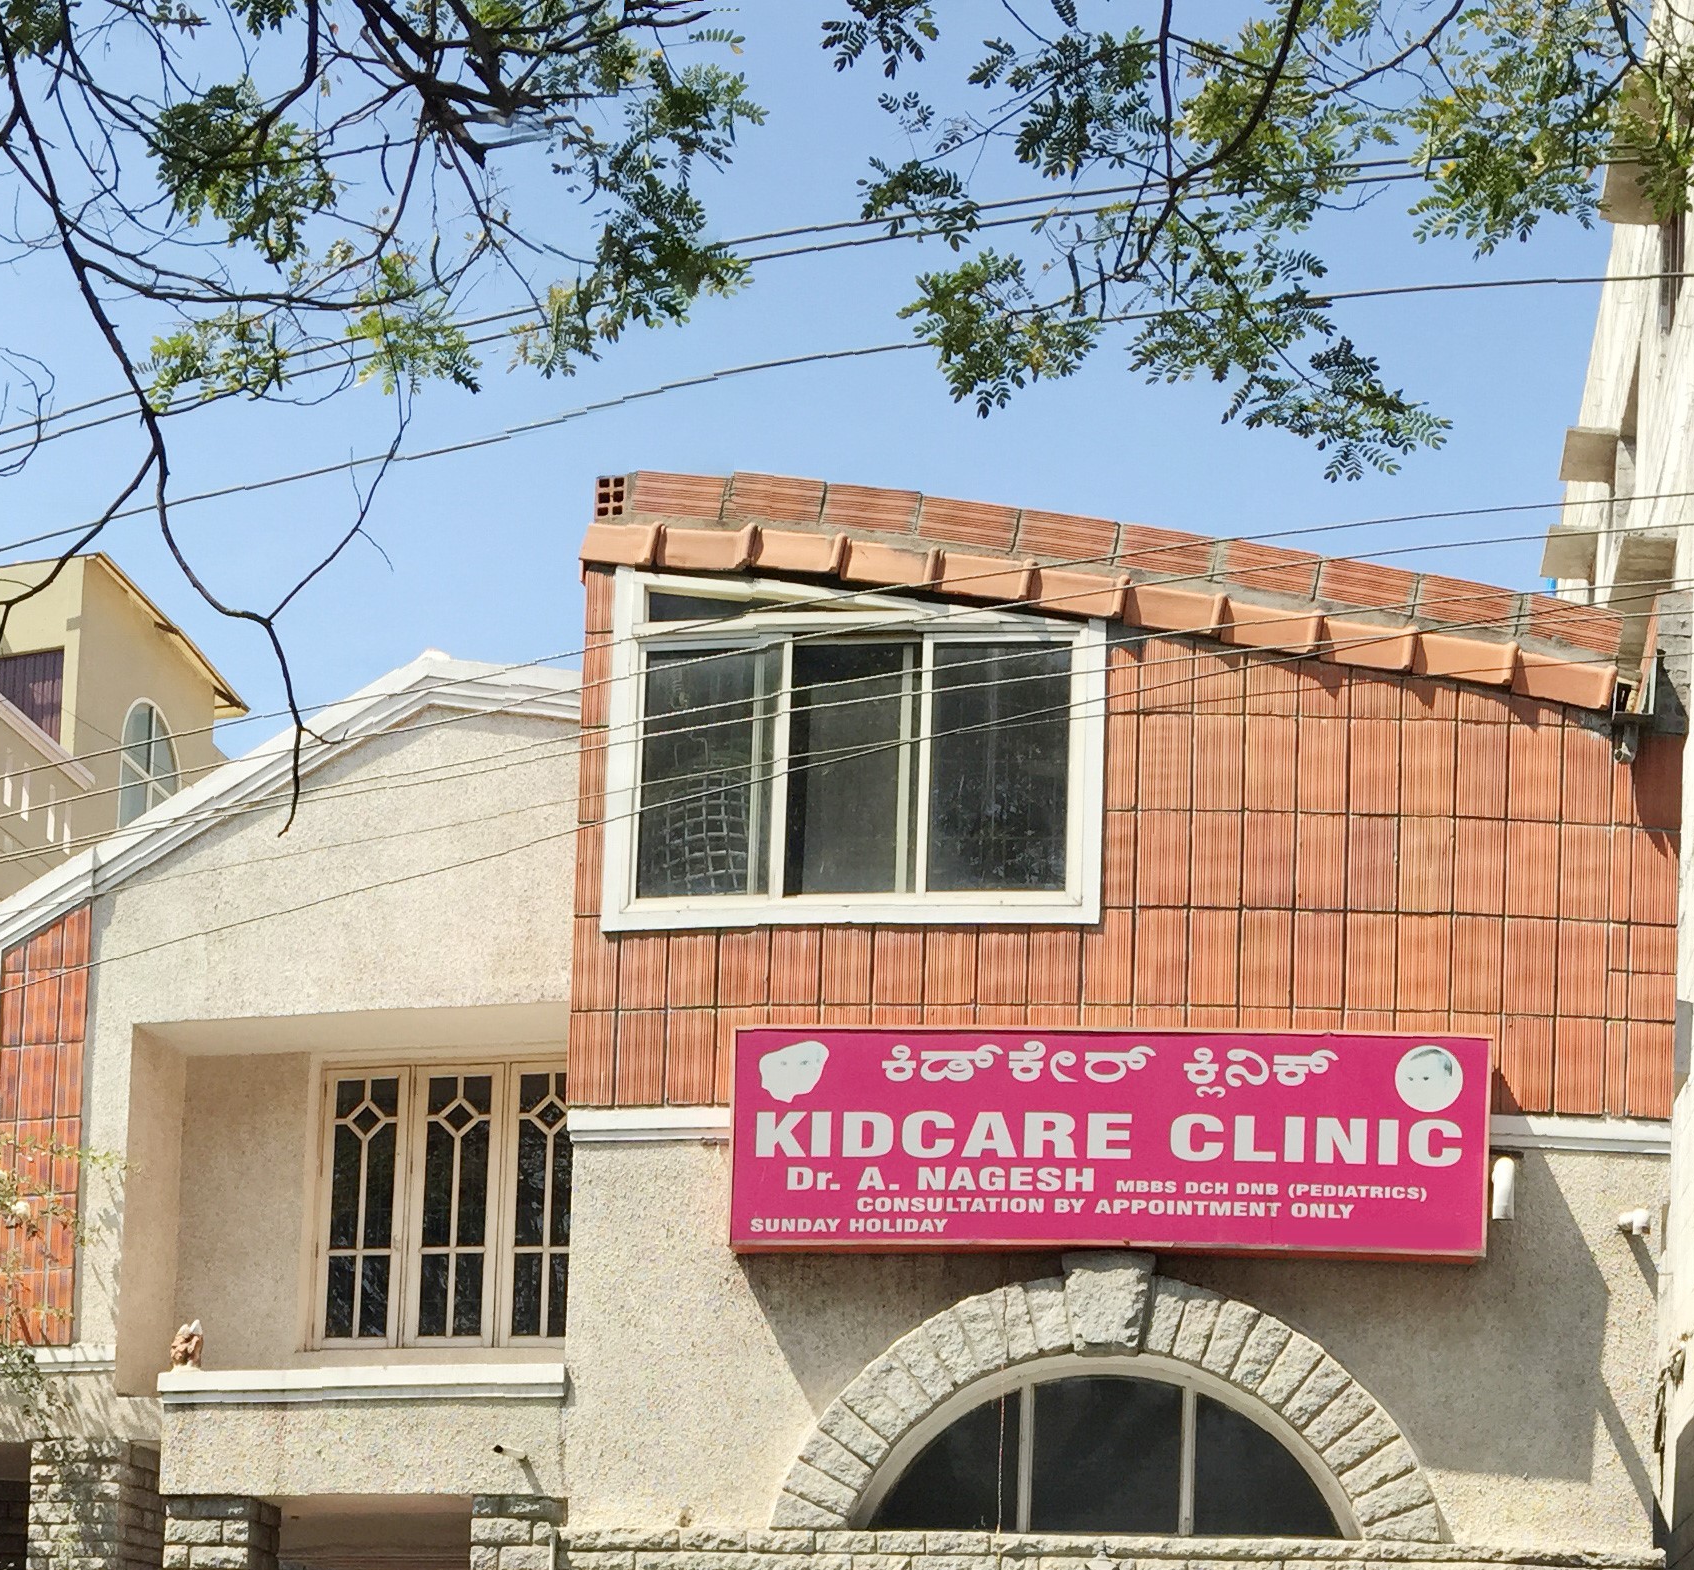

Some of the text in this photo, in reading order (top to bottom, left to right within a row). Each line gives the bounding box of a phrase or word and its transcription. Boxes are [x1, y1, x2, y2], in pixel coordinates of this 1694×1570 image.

[1183, 1047, 1339, 1098] ಕ್ಲಿನಿಕ್
[755, 1110, 1463, 1167] KIDCARE CLINIC
[787, 1167, 1428, 1200] Dr. A. NAGESH MBBS DCH DNB (PEDIATRICS)
[856, 1197, 1355, 1220] CONSULTATION BY APPOINTMENT ONLY
[750, 1218, 949, 1234] SUNDAY HOLIDAY
